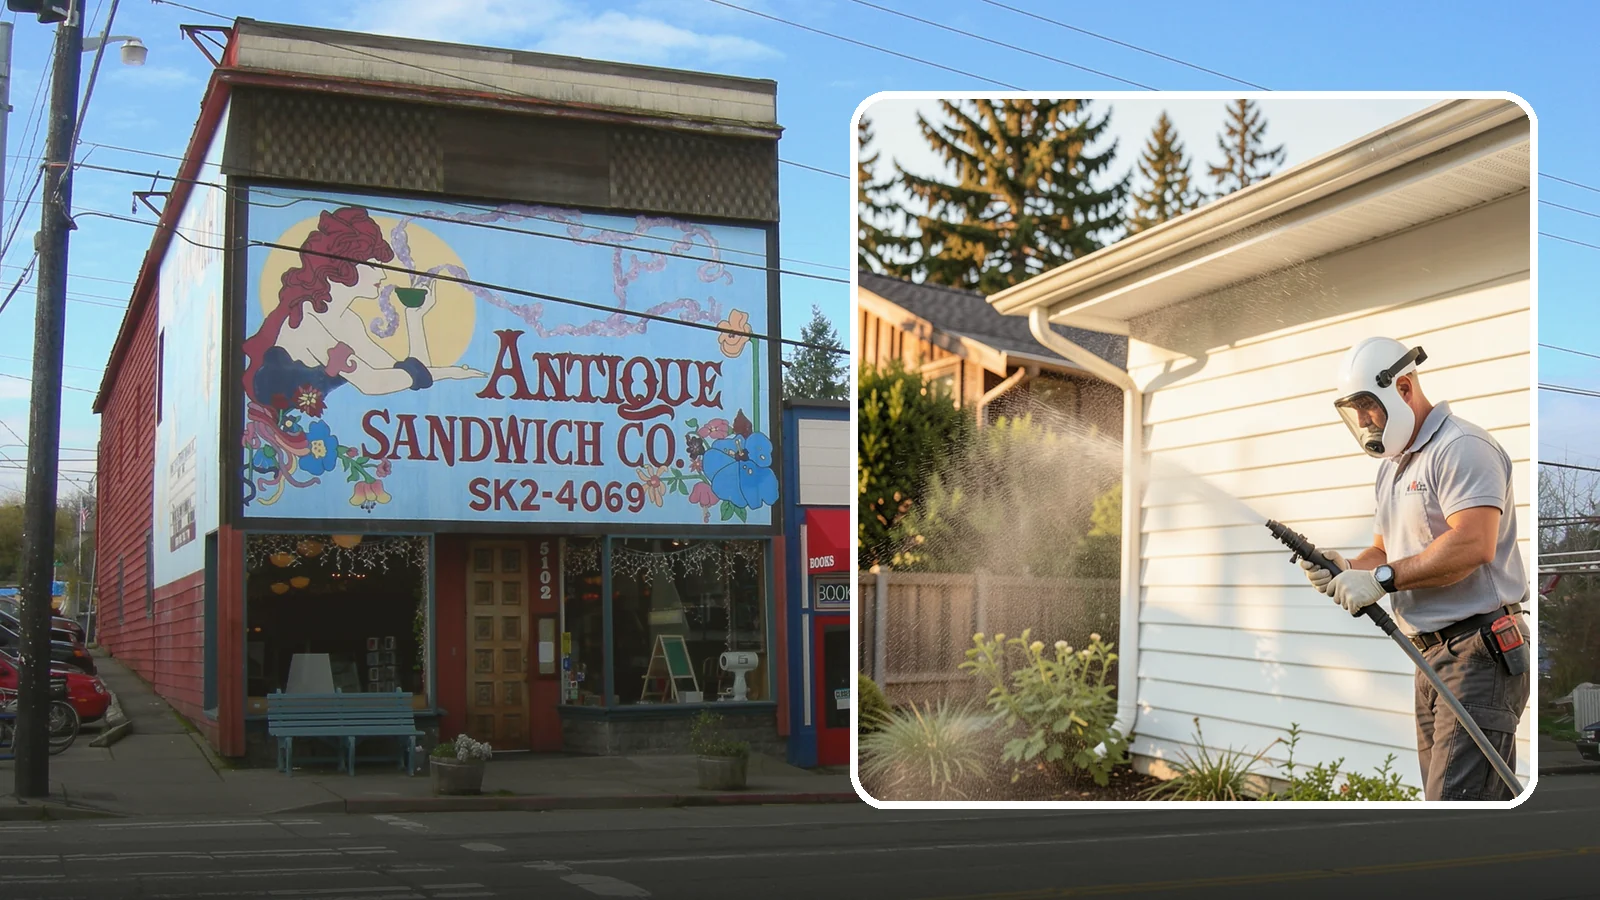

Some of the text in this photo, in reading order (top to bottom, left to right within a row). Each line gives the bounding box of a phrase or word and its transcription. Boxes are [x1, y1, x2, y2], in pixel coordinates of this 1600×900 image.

[476, 329, 724, 420] ANTIQUE
[361, 407, 685, 469] SANDWICH CO.
[469, 477, 646, 512] SK2-4069
[540, 541, 552, 599] 5102
[809, 555, 834, 569] BOOKS
